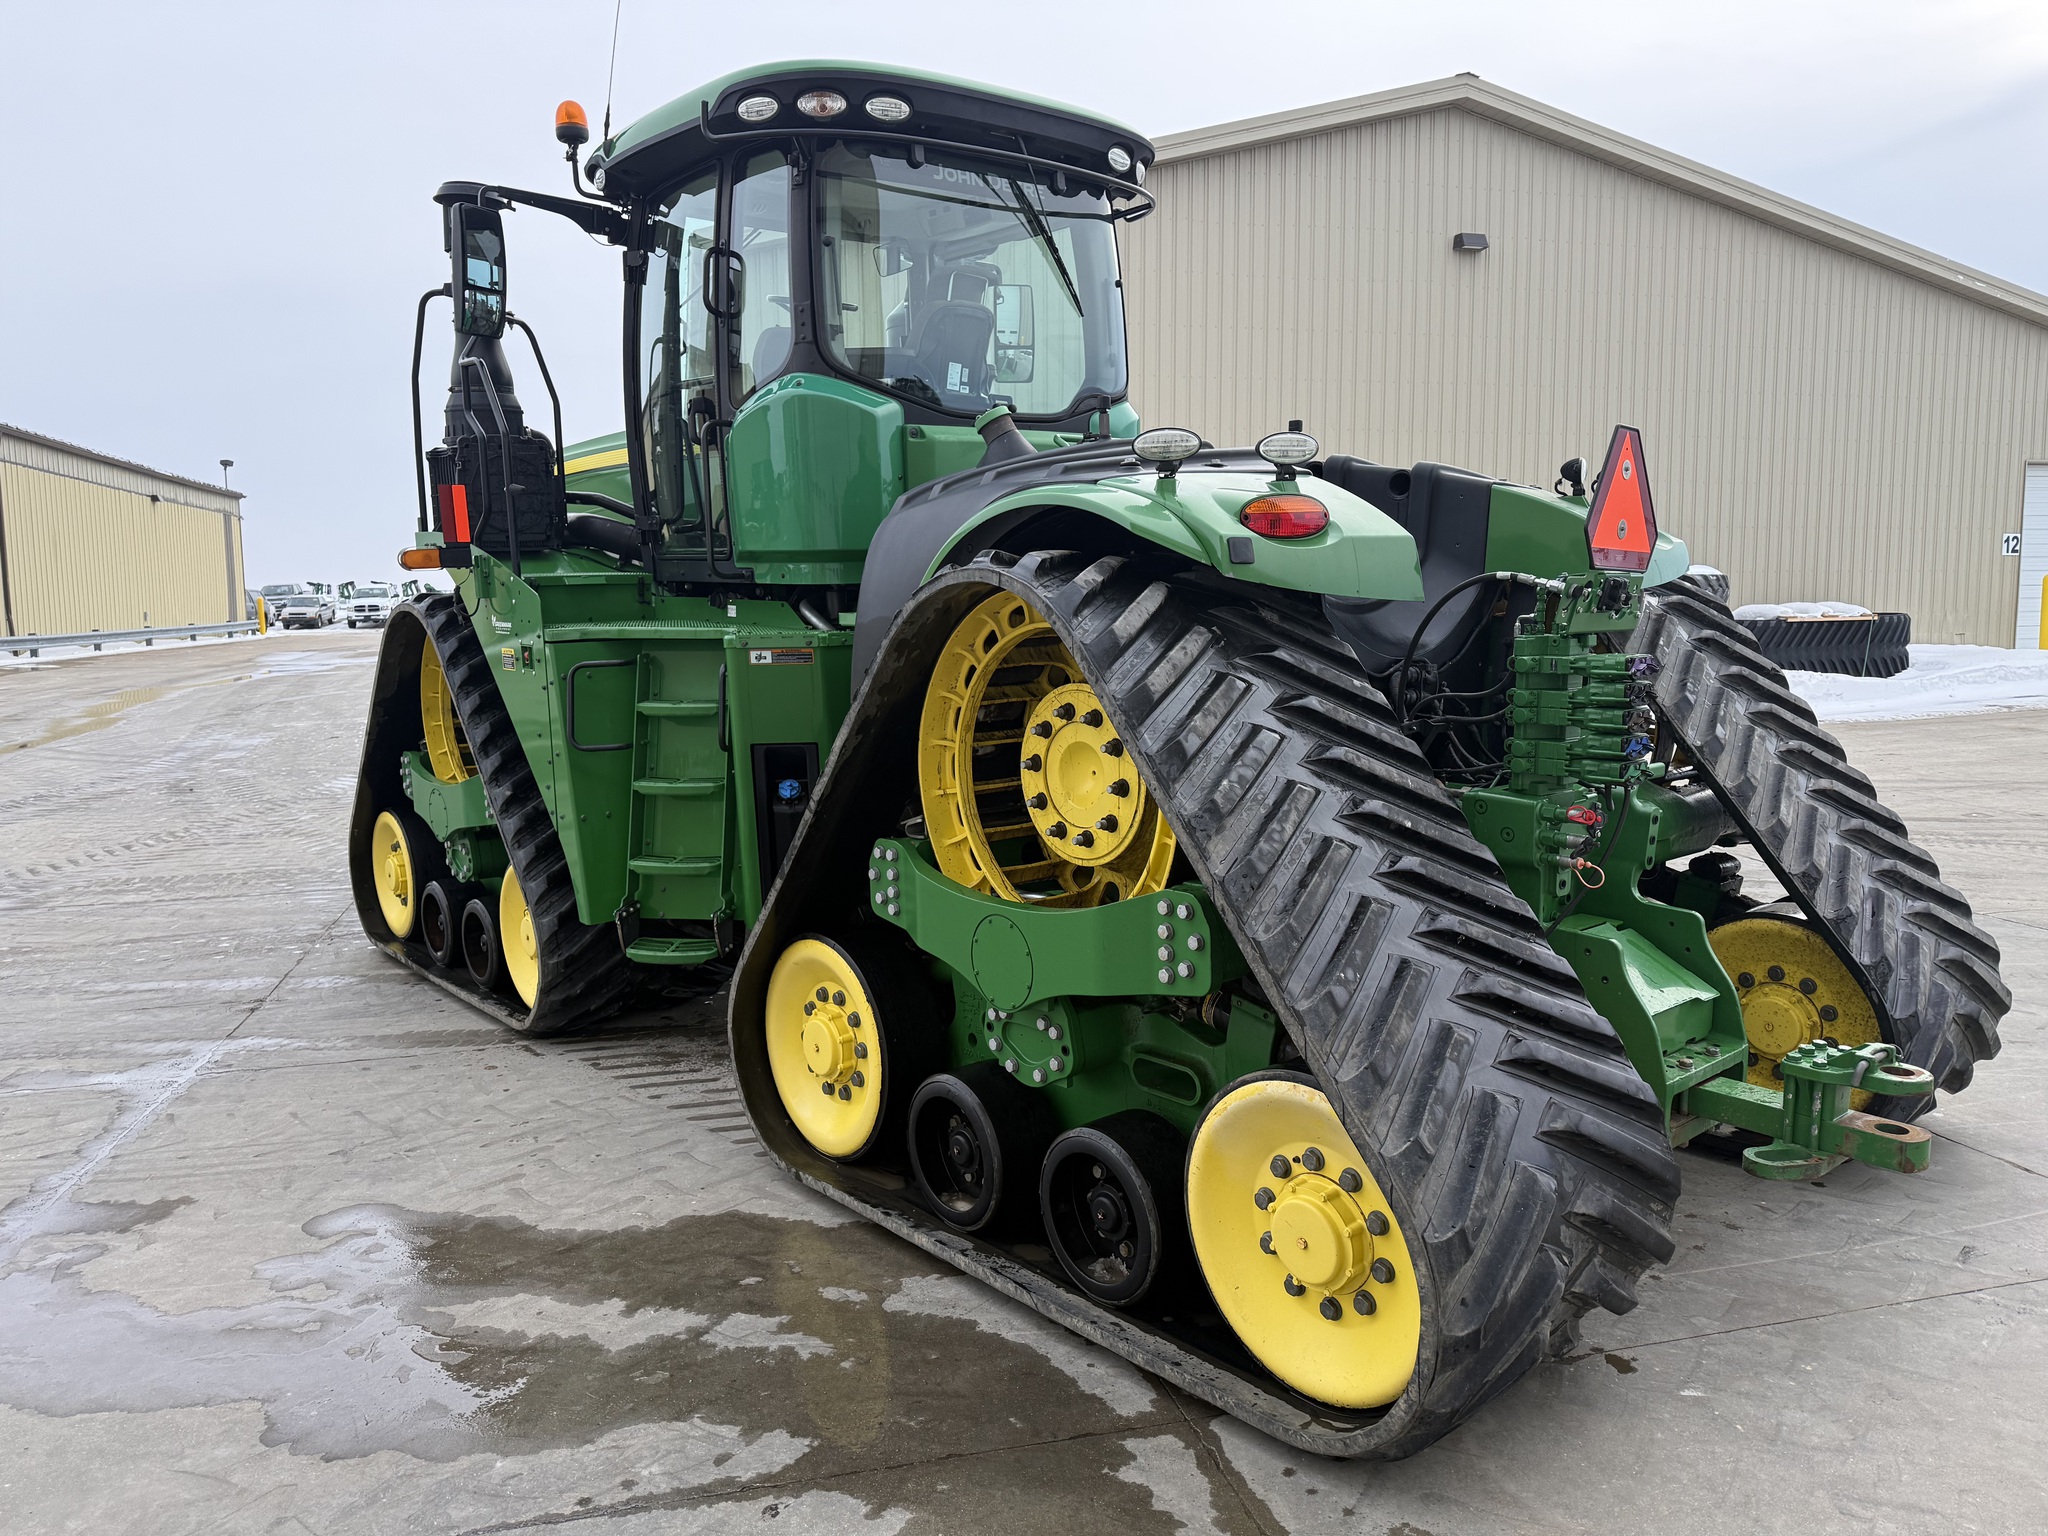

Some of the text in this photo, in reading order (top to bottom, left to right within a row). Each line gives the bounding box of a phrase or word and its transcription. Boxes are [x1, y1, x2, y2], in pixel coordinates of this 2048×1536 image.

[933, 163, 1046, 199] JOHN DERE
[2004, 535, 2020, 554] 12
